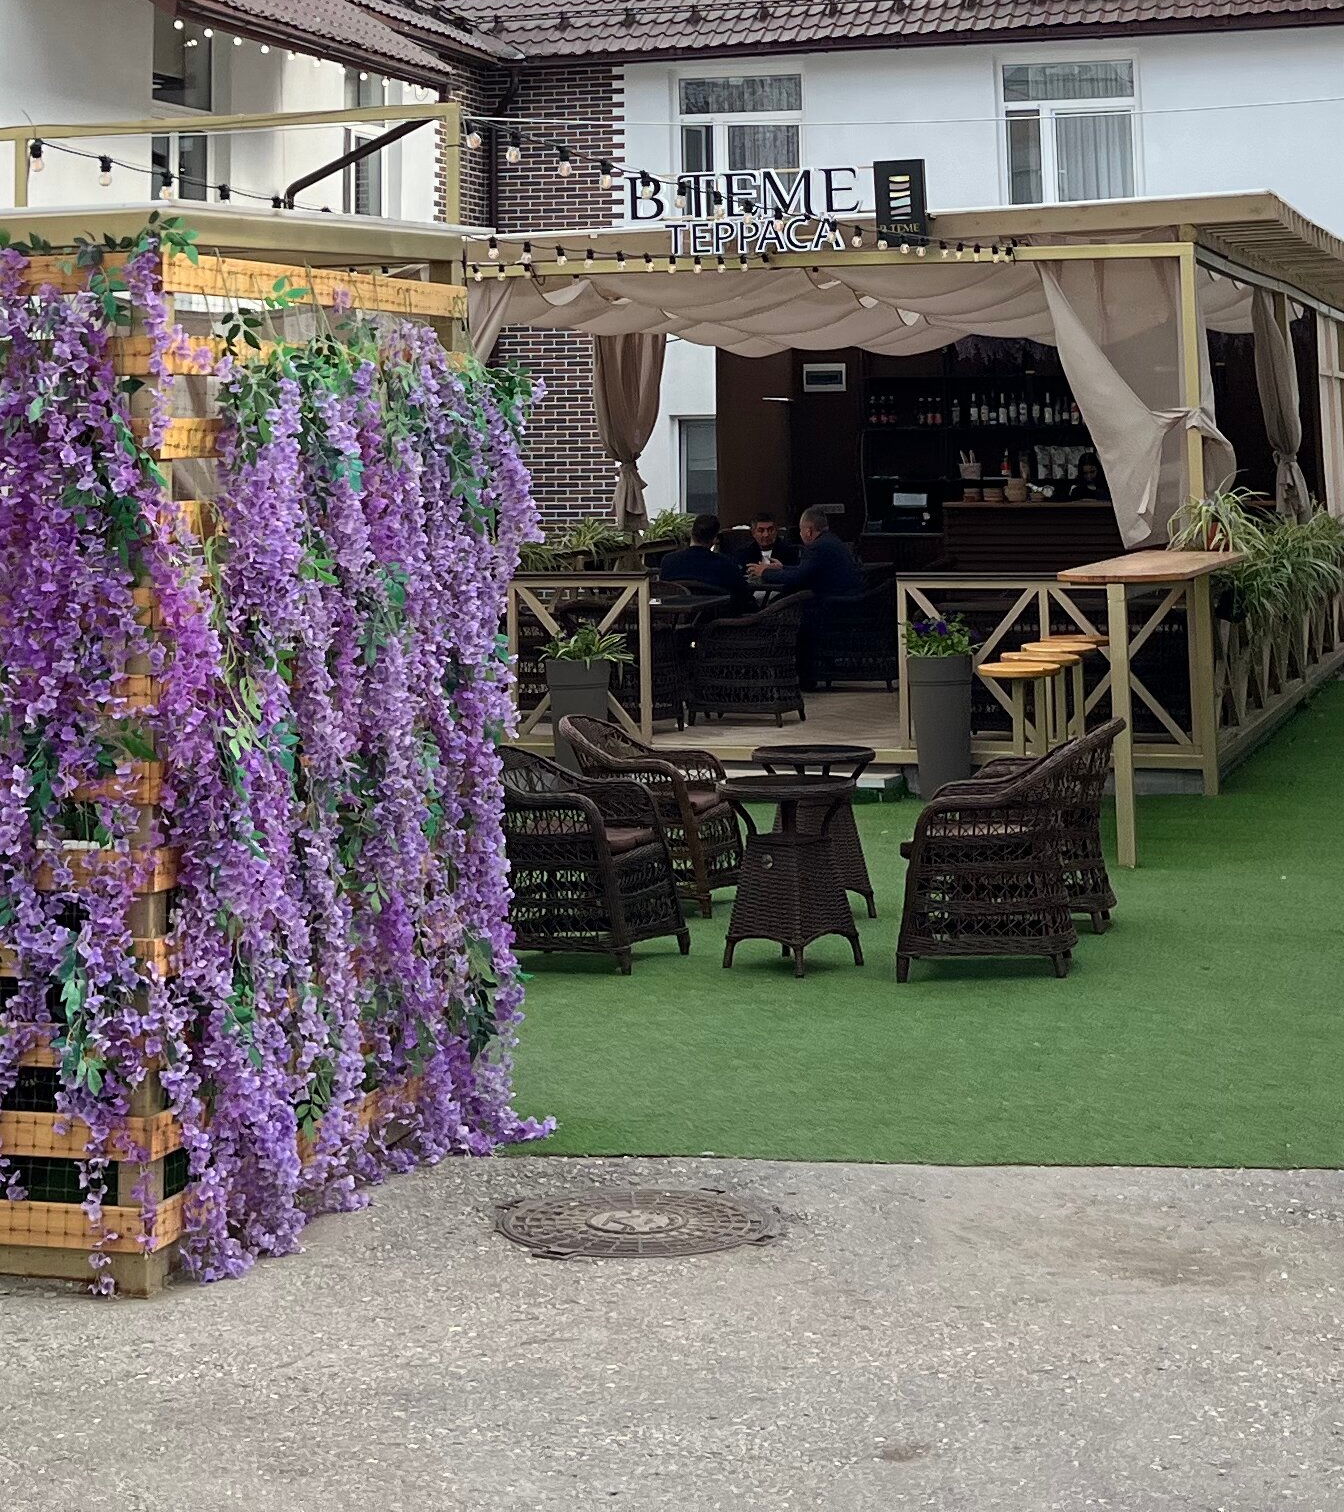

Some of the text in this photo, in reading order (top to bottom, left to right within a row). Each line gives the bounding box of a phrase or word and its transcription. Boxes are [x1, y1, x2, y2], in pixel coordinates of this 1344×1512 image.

[624, 166, 861, 222] В ТЕМЕ
[663, 214, 845, 258] ТЕРРАСА
